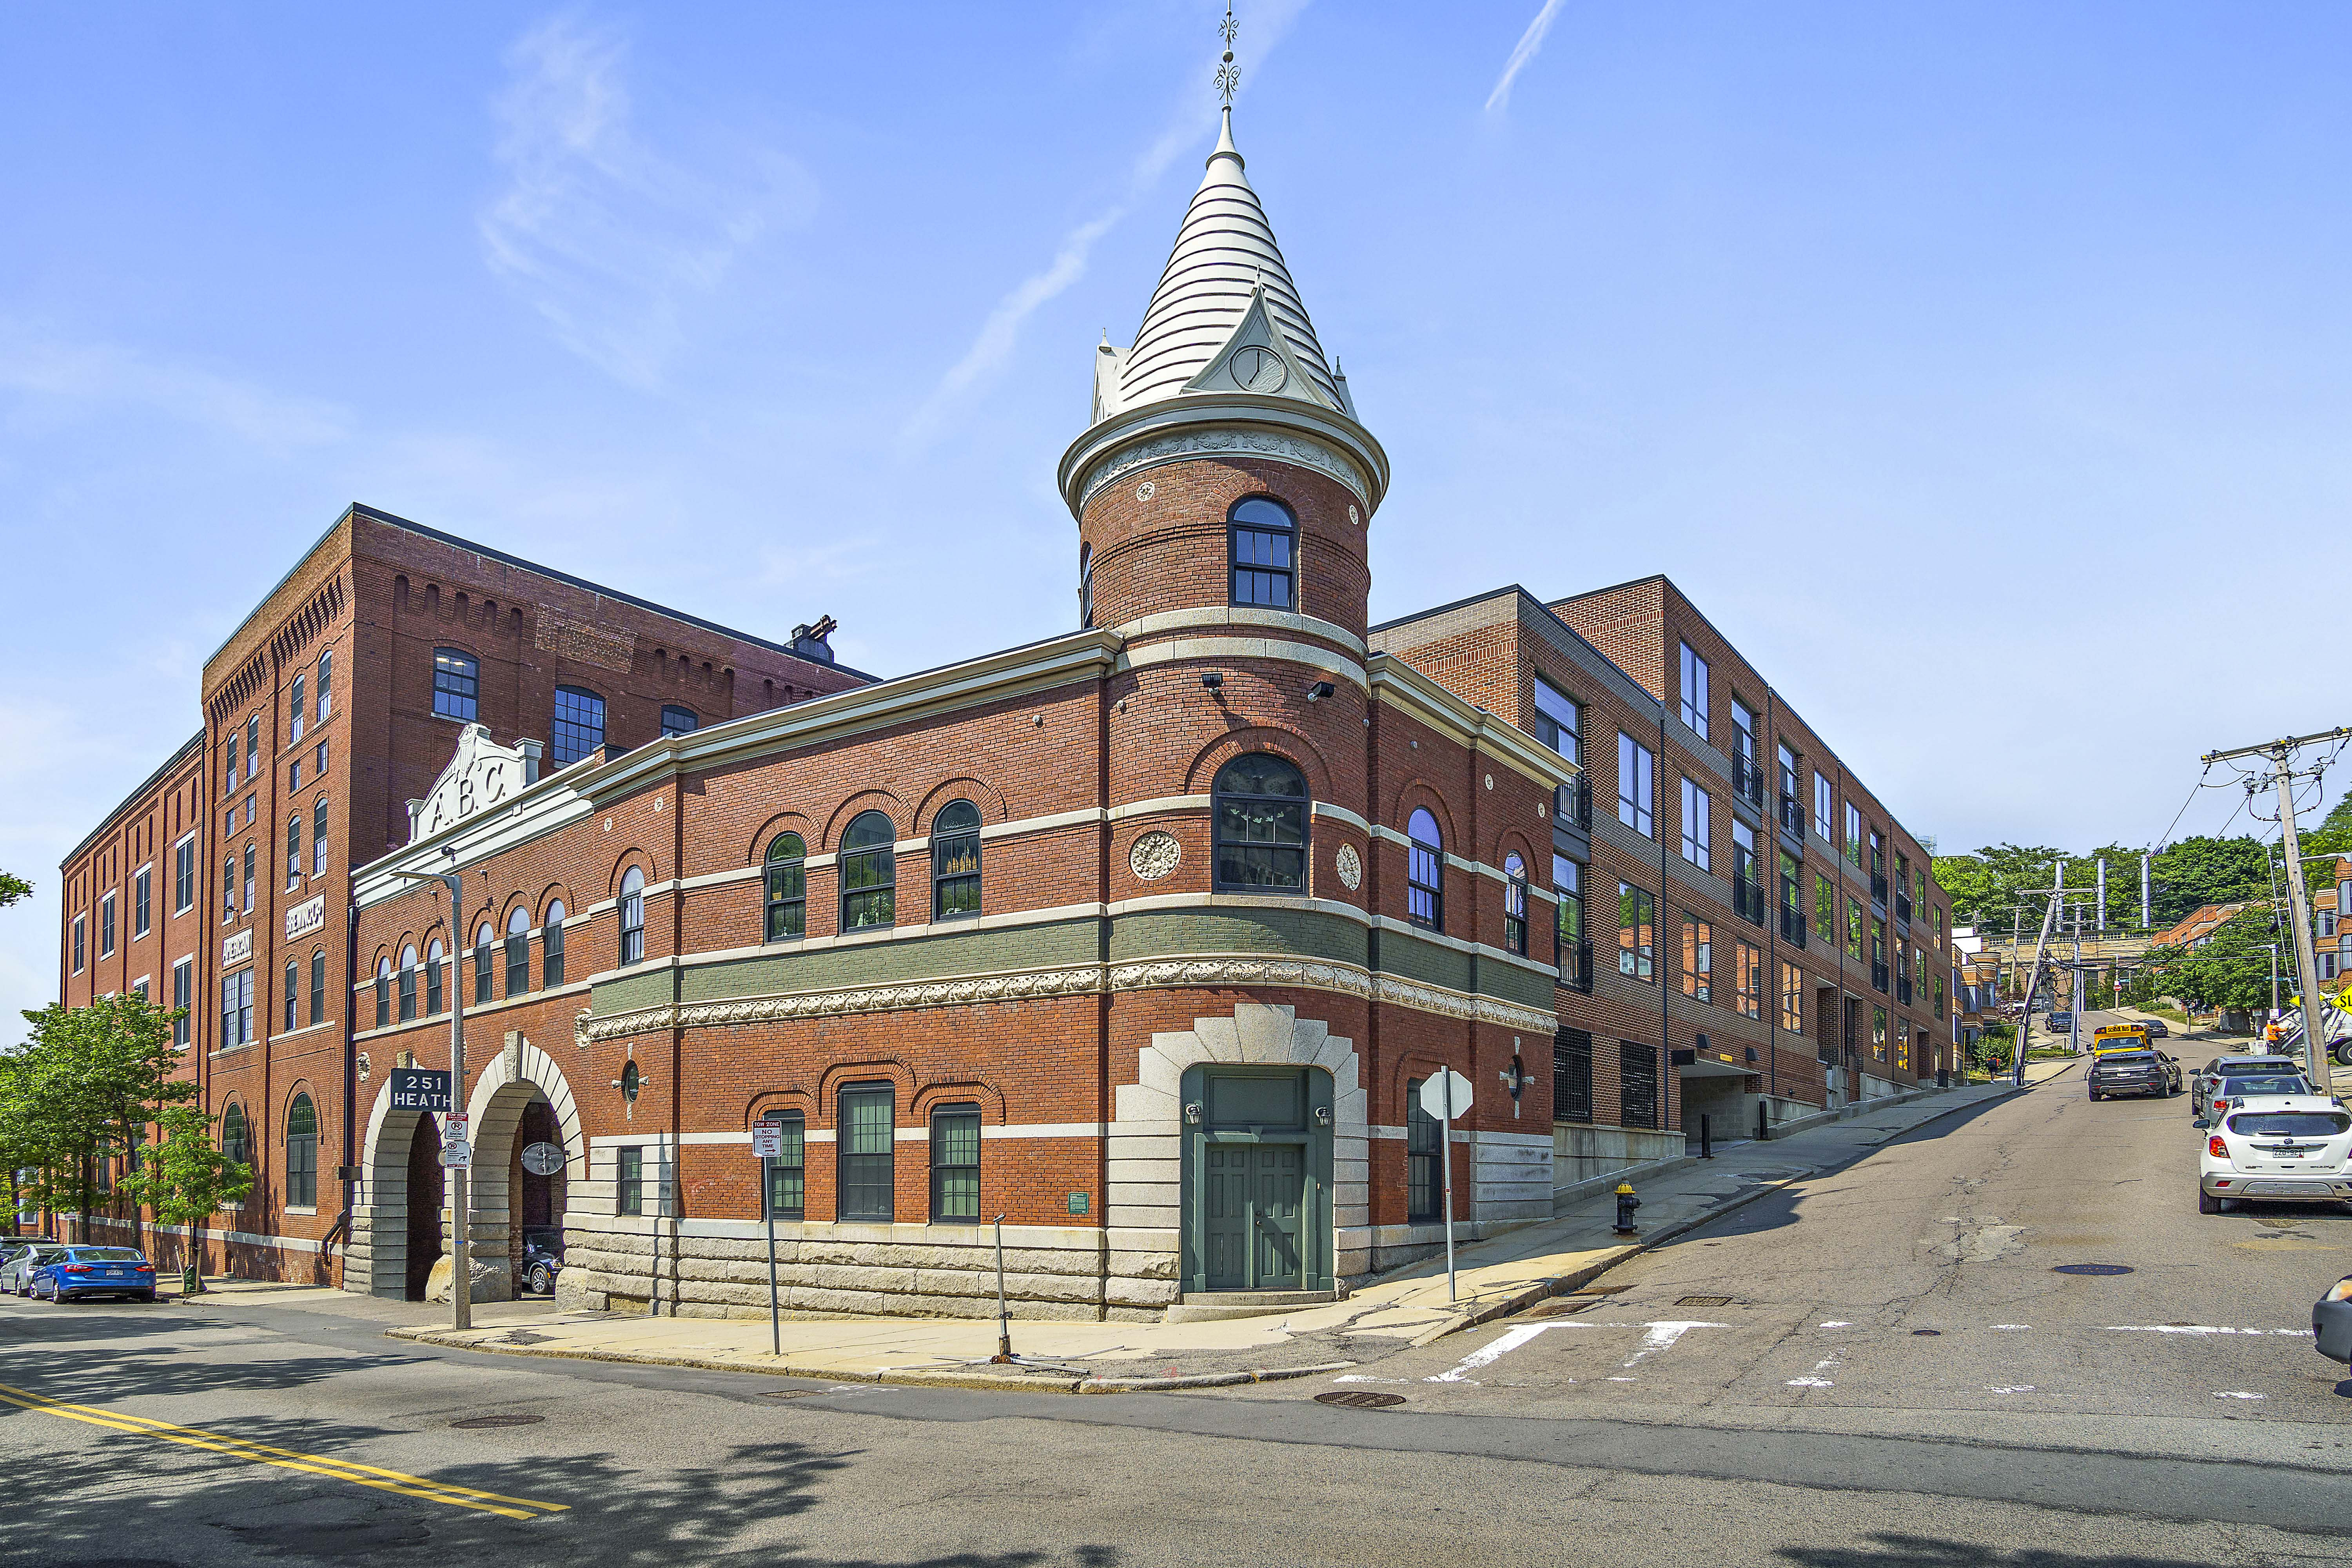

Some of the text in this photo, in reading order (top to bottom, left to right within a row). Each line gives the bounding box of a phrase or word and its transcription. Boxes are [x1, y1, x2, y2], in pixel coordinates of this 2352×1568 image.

[286, 907, 313, 936] BREWING
[222, 934, 251, 962] AMERICAN
[407, 1076, 441, 1090] 251
[394, 1092, 452, 1107] HEATH
